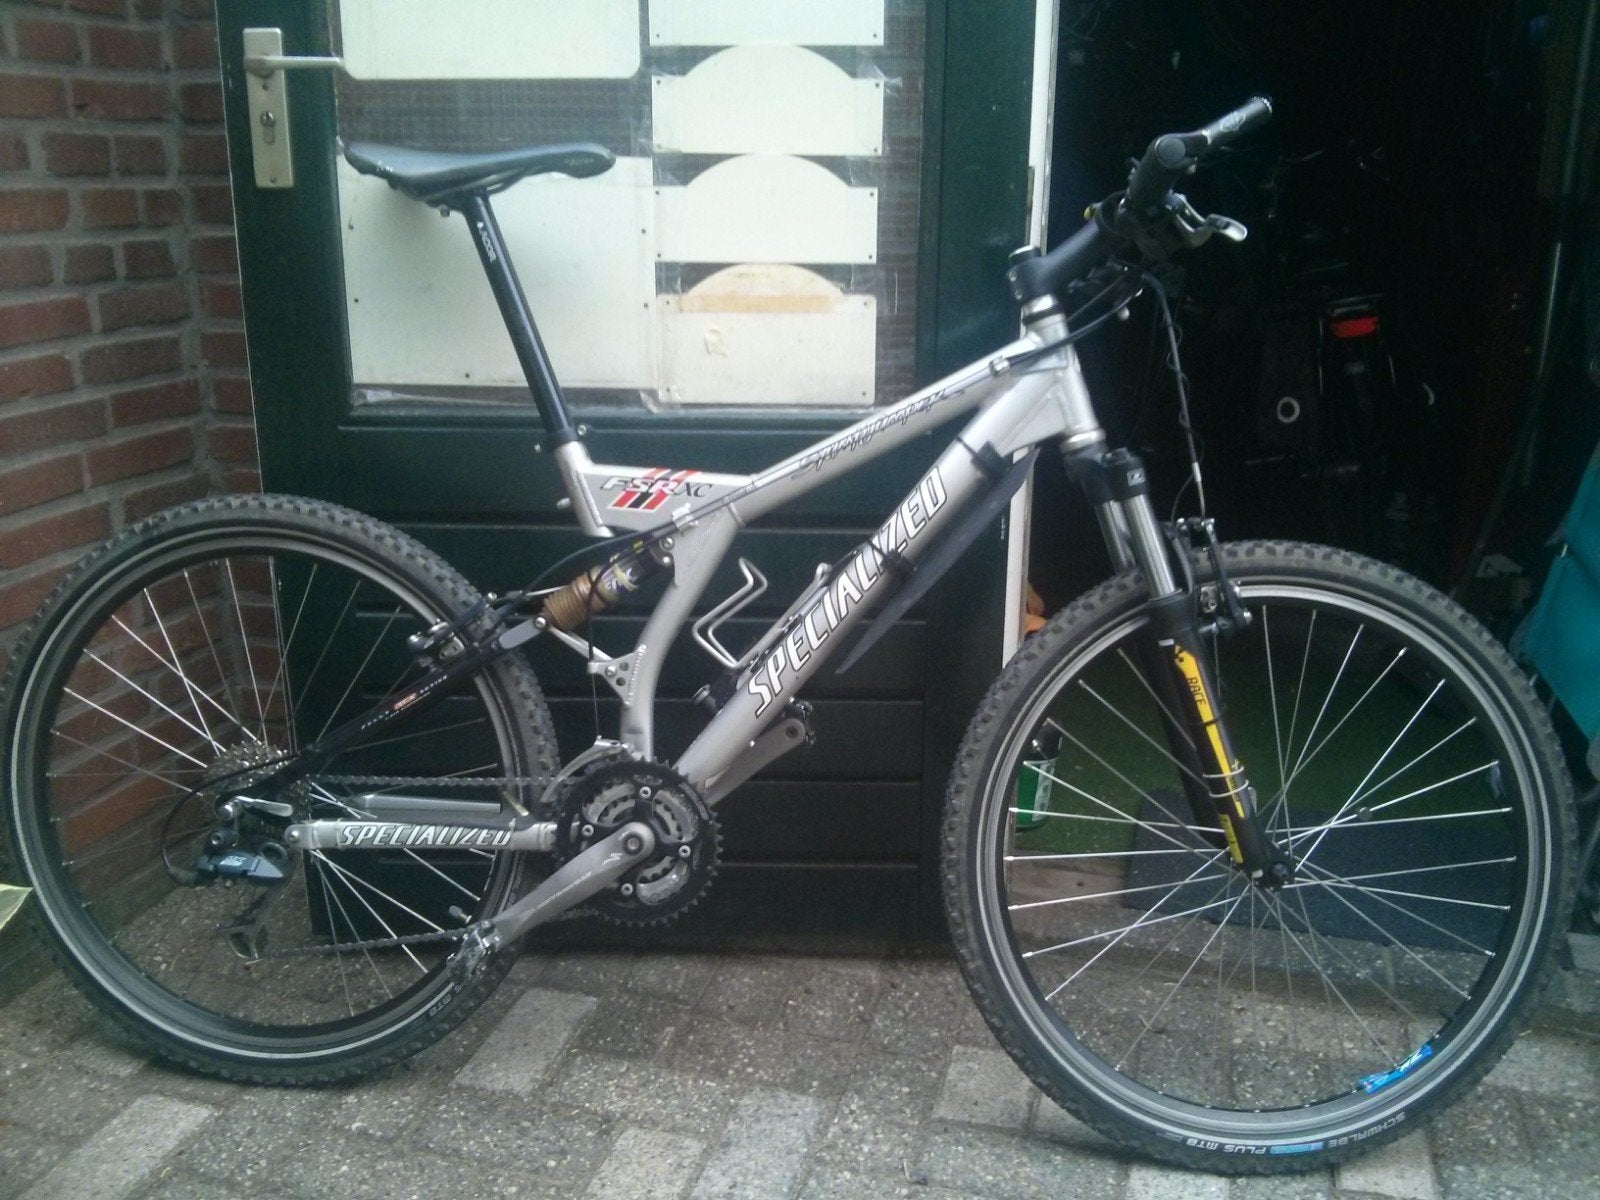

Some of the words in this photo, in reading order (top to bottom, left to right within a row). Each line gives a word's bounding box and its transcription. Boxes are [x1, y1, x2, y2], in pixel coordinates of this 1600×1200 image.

[600, 475, 678, 495] FSR
[674, 481, 713, 498] XC
[748, 466, 948, 719] SPECIALIZED
[1187, 676, 1208, 706] RACE
[339, 823, 512, 847] SPECIALIZED
[1327, 1111, 1406, 1149] SCHWALBE
[1186, 1137, 1219, 1151] MTB
[1223, 1143, 1268, 1155] PLUS
